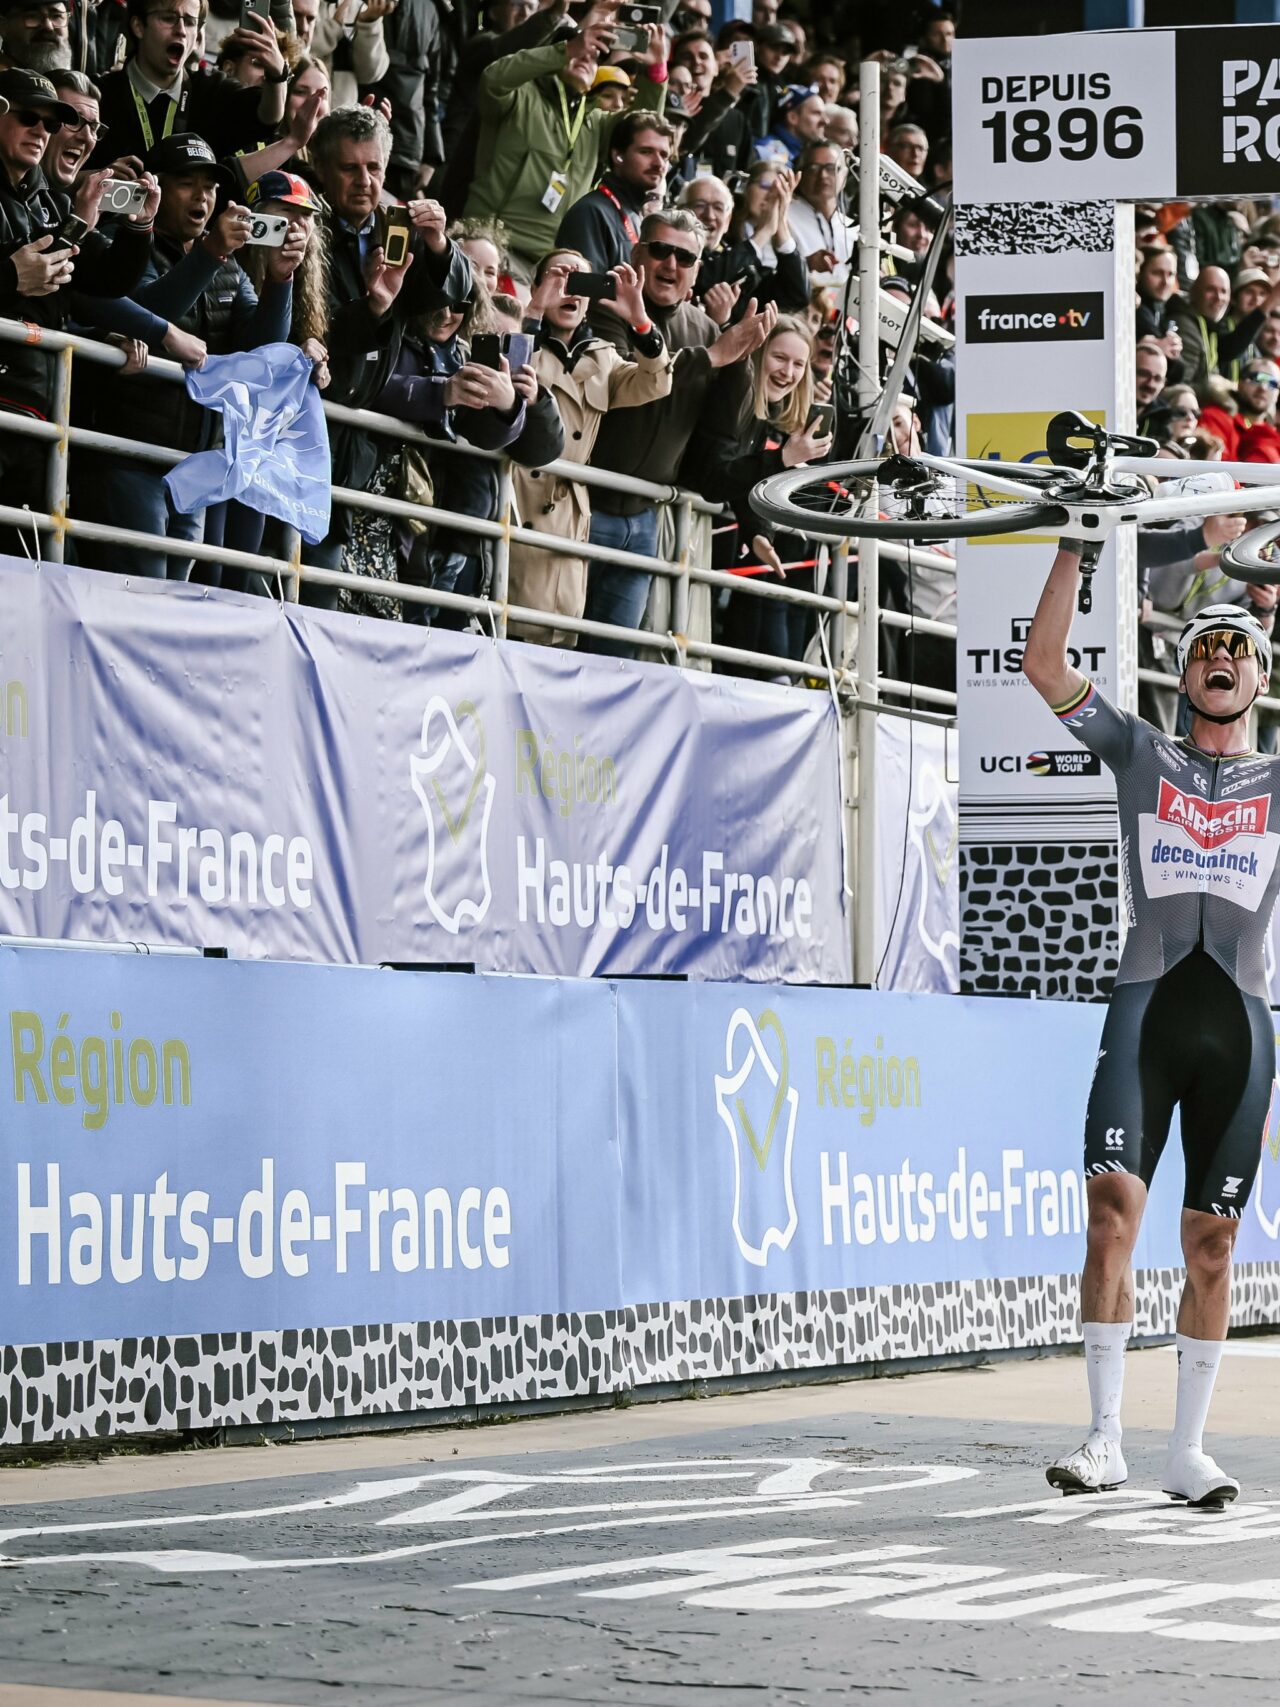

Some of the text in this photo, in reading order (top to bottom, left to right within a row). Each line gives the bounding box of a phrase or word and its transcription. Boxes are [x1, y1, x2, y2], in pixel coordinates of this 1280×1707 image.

[982, 73, 1111, 103] DEPUIS
[982, 106, 1144, 164] 1896
[967, 647, 1106, 673] TISOT
[1001, 679, 1030, 687] WATC
[514, 728, 617, 817] Région
[980, 756, 1021, 773] UCI
[1054, 754, 1091, 763] WORLD
[1056, 763, 1083, 772] TOUR
[1167, 814, 1193, 829] HAIR
[1168, 793, 1257, 833] Alpecin
[0, 789, 313, 908] ts-de-France
[1151, 839, 1258, 877] deceuninck
[516, 835, 812, 939] Hauts-de-France
[1175, 870, 1231, 884] WINDOWS
[10, 1010, 192, 1130] Région
[816, 1036, 921, 1127] Région
[819, 1146, 1087, 1247] Hauts-de-Fran
[17, 1157, 512, 1286] Hauts-de-France
